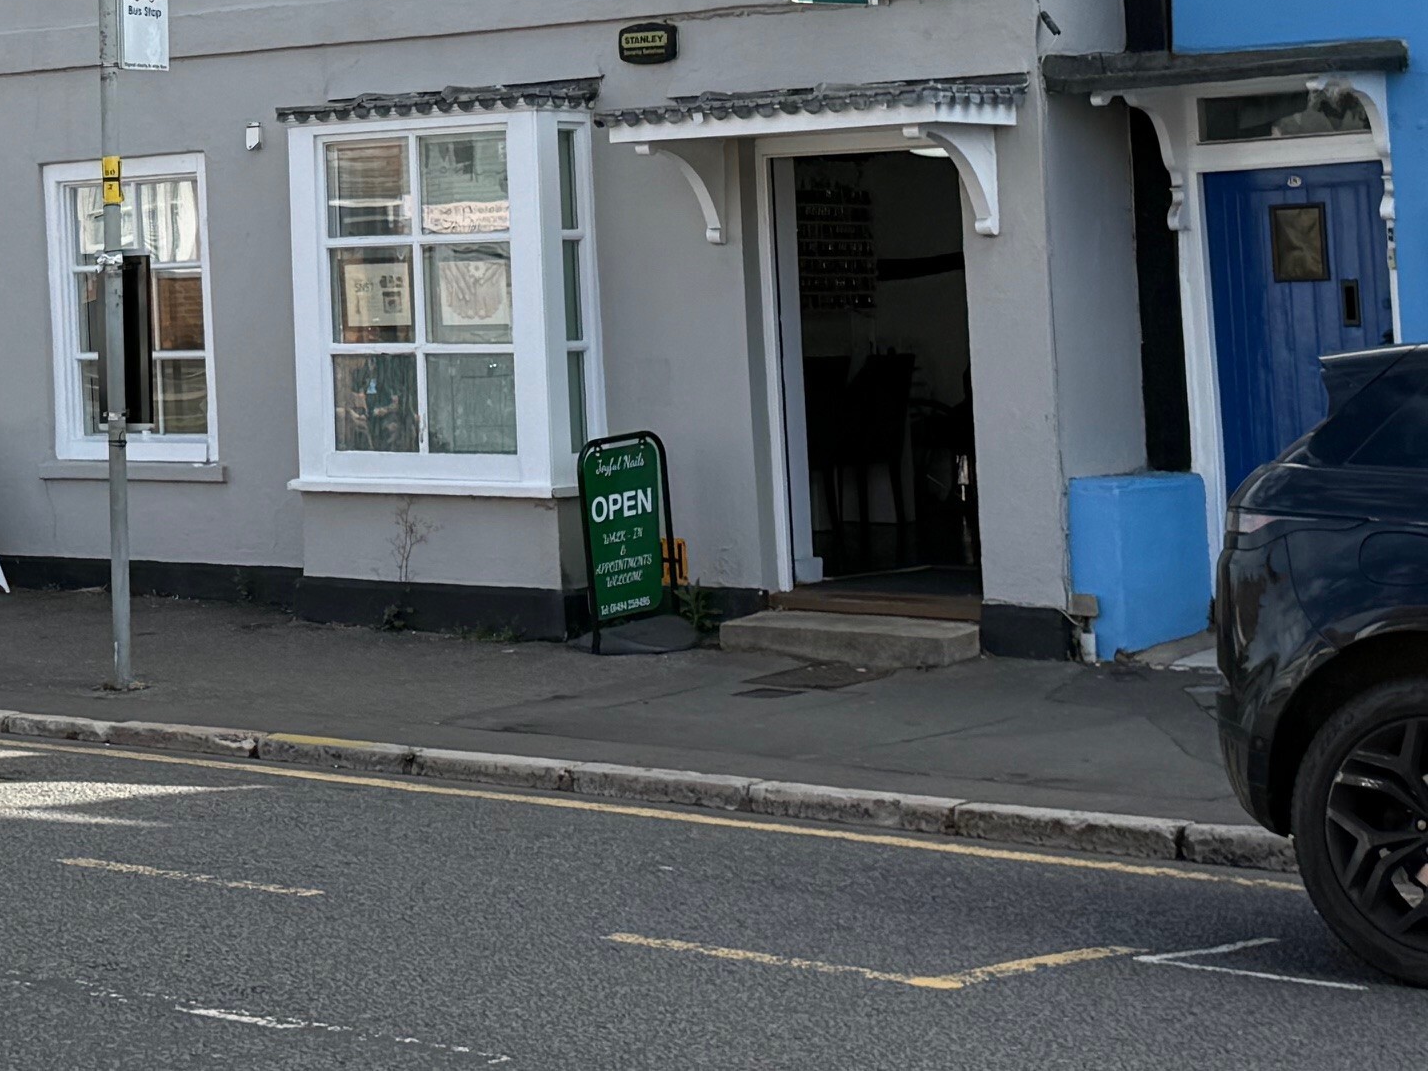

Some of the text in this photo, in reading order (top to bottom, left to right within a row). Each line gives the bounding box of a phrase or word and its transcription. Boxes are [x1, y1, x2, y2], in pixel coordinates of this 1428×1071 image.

[128, 5, 162, 19] Bus Stop
[624, 34, 664, 45] STANLEY
[595, 452, 645, 477] Joyful Nails
[591, 487, 652, 523] OPEN
[595, 553, 653, 575] APPOINTMENTS
[606, 569, 643, 588] WELCOME
